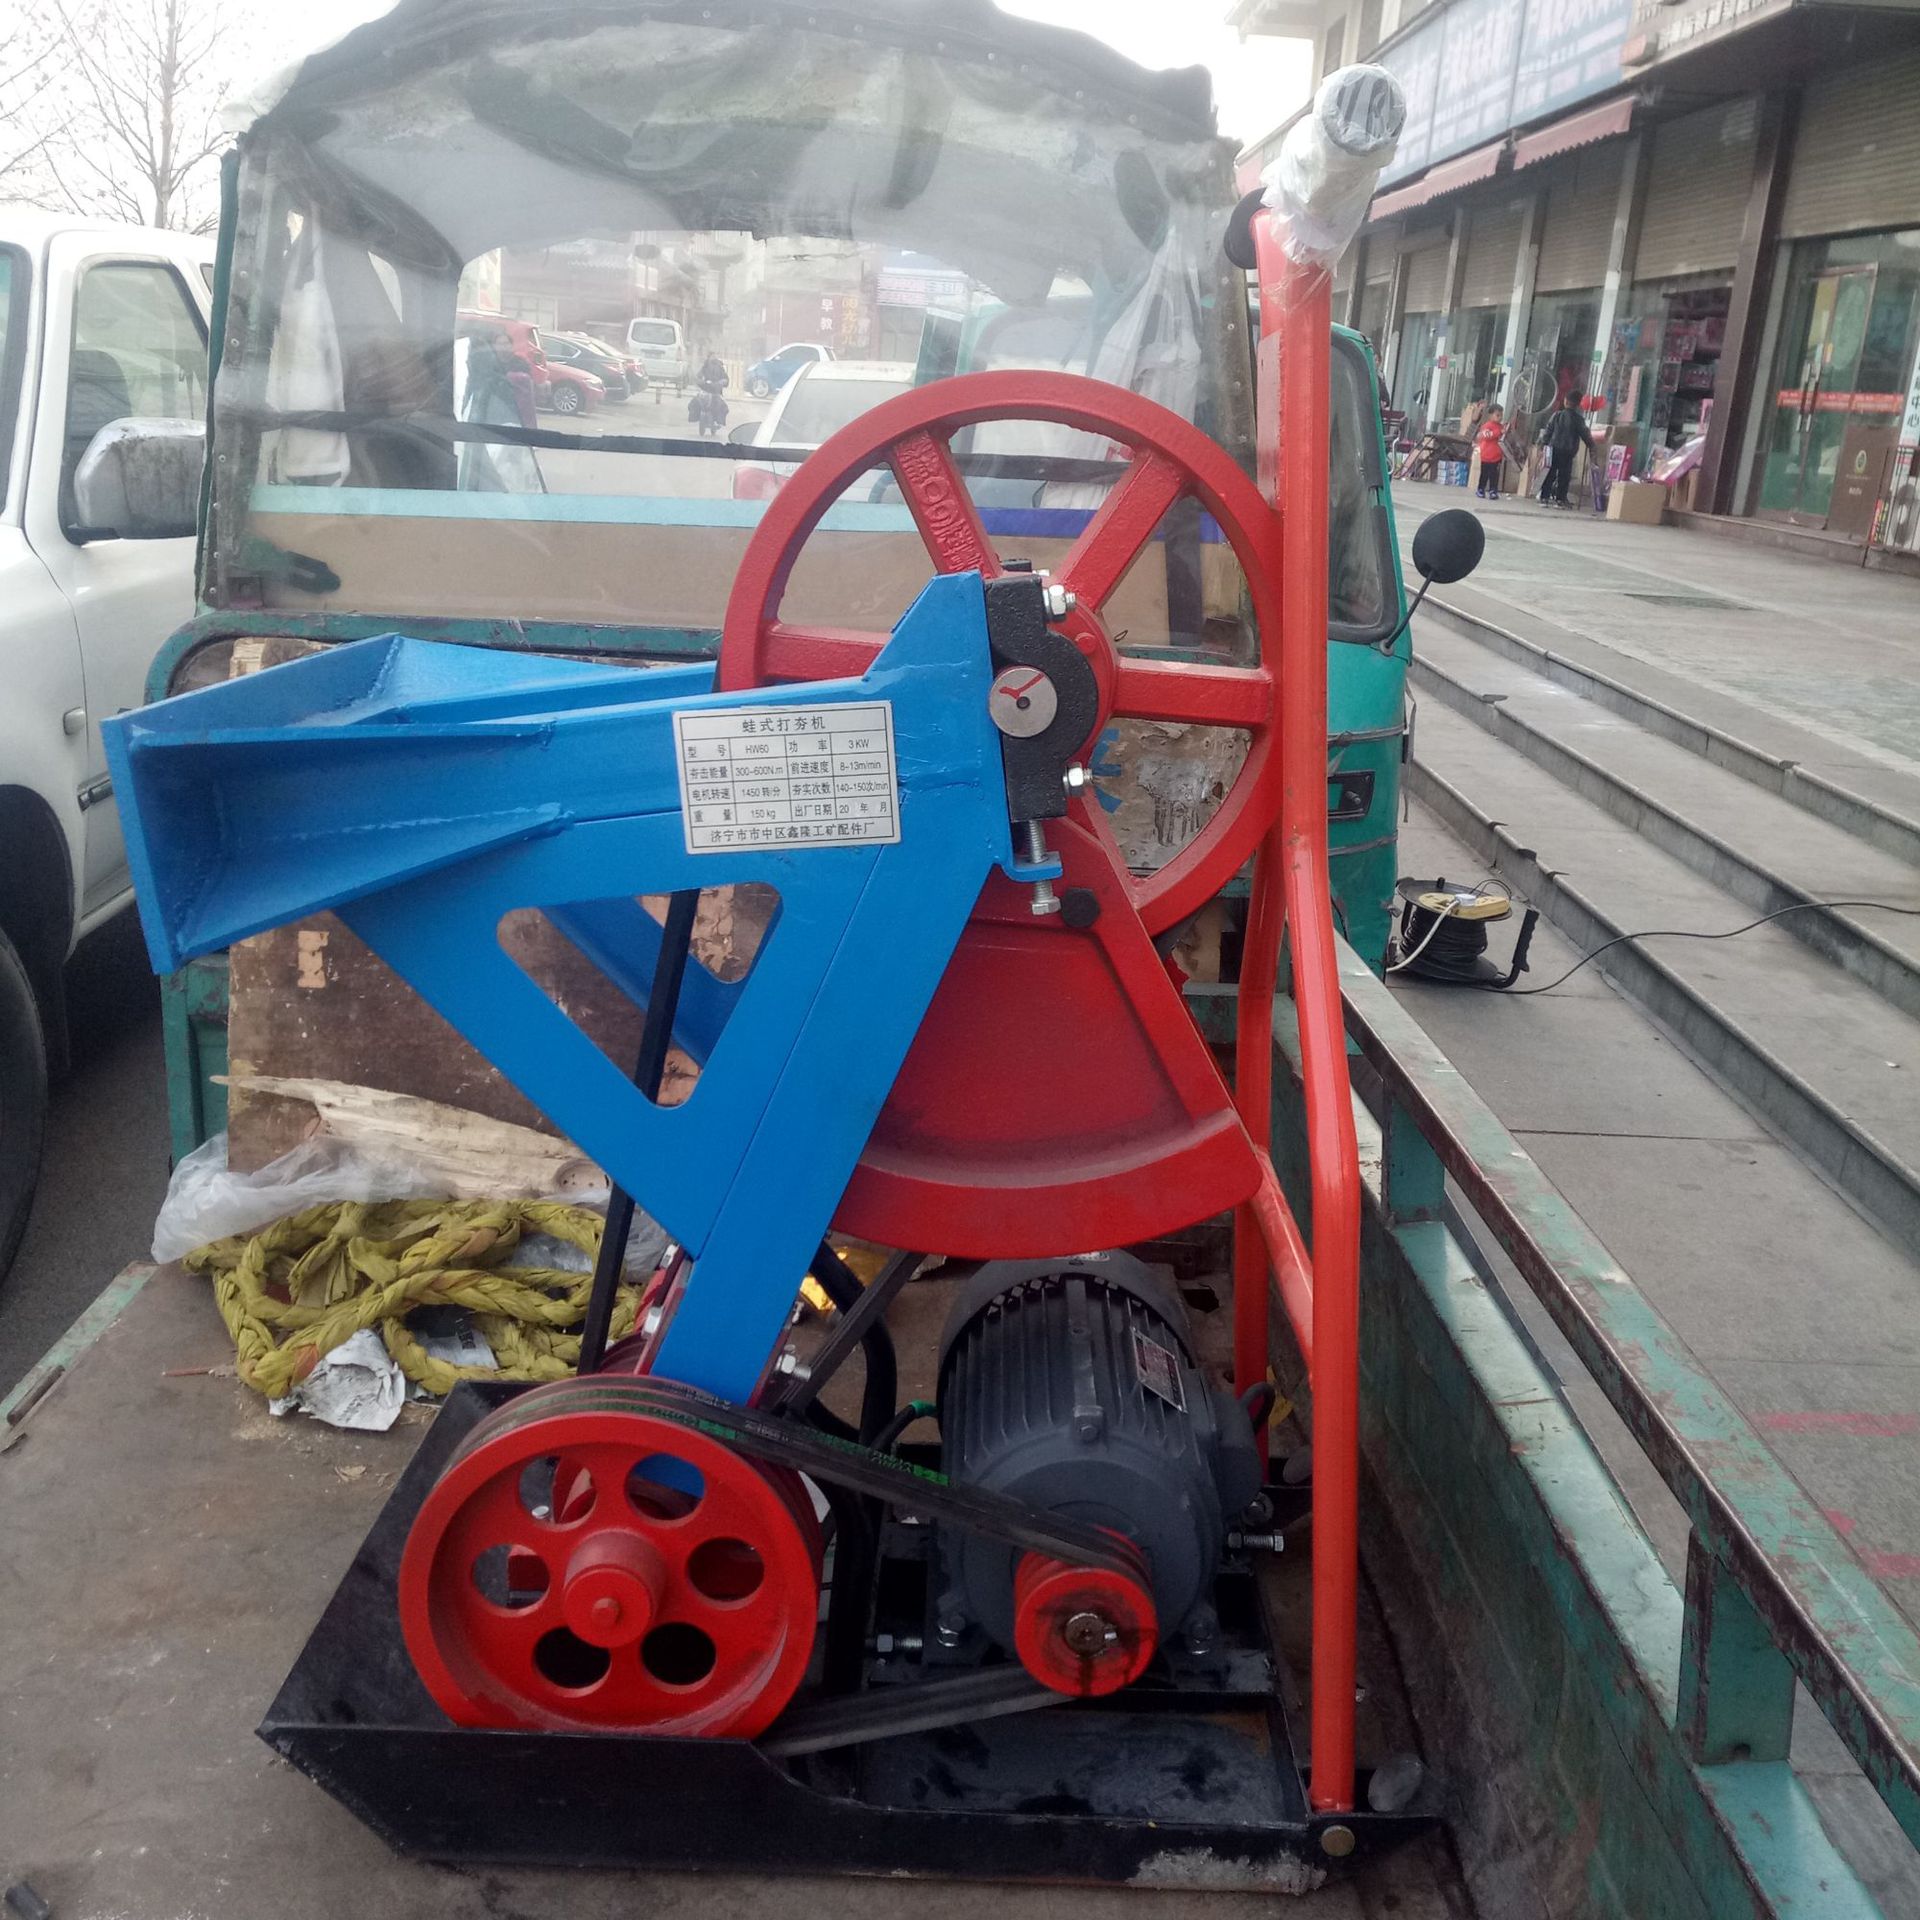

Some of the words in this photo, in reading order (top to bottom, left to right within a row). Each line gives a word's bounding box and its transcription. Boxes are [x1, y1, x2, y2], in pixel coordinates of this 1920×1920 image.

[820, 298, 833, 330] 早教
[742, 716, 826, 733] 蛙式打夯机
[745, 744, 769, 754] HW60
[689, 765, 728, 779] 夯击能量
[790, 760, 829, 775] 前进速度
[692, 787, 731, 801] 电机转速
[792, 782, 831, 796] 夯实次数
[794, 804, 832, 817] 出厂日期
[711, 821, 875, 843] 济宁市市中区鑫隆工矿配件厂
